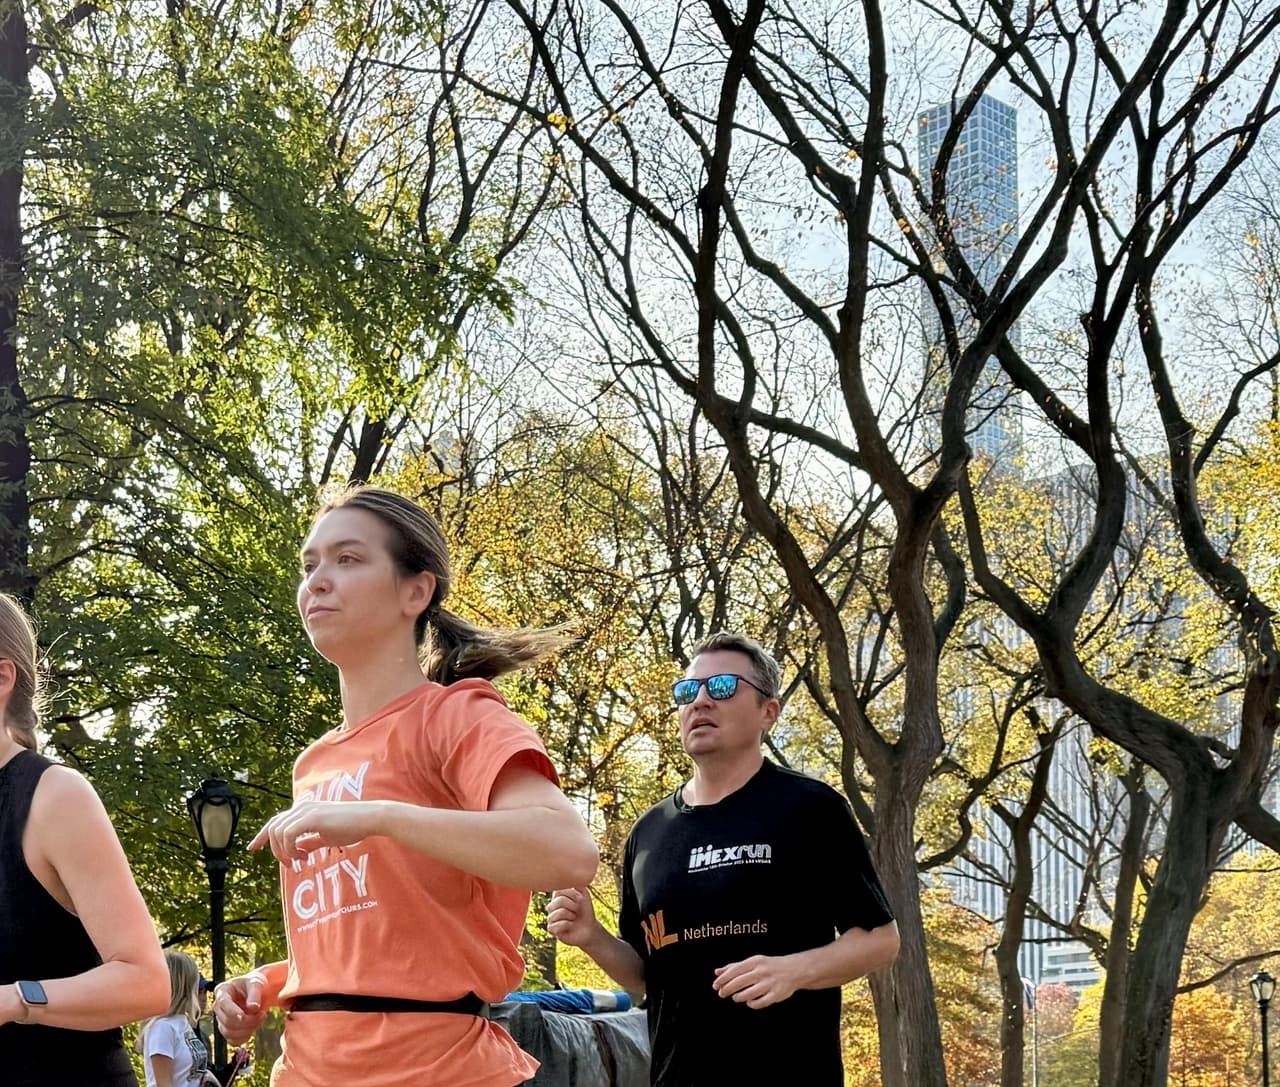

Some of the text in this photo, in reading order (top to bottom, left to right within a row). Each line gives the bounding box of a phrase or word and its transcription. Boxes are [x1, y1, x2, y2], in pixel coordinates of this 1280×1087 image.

[293, 853, 370, 920] CITY
[640, 910, 769, 956] NL Netherlands
